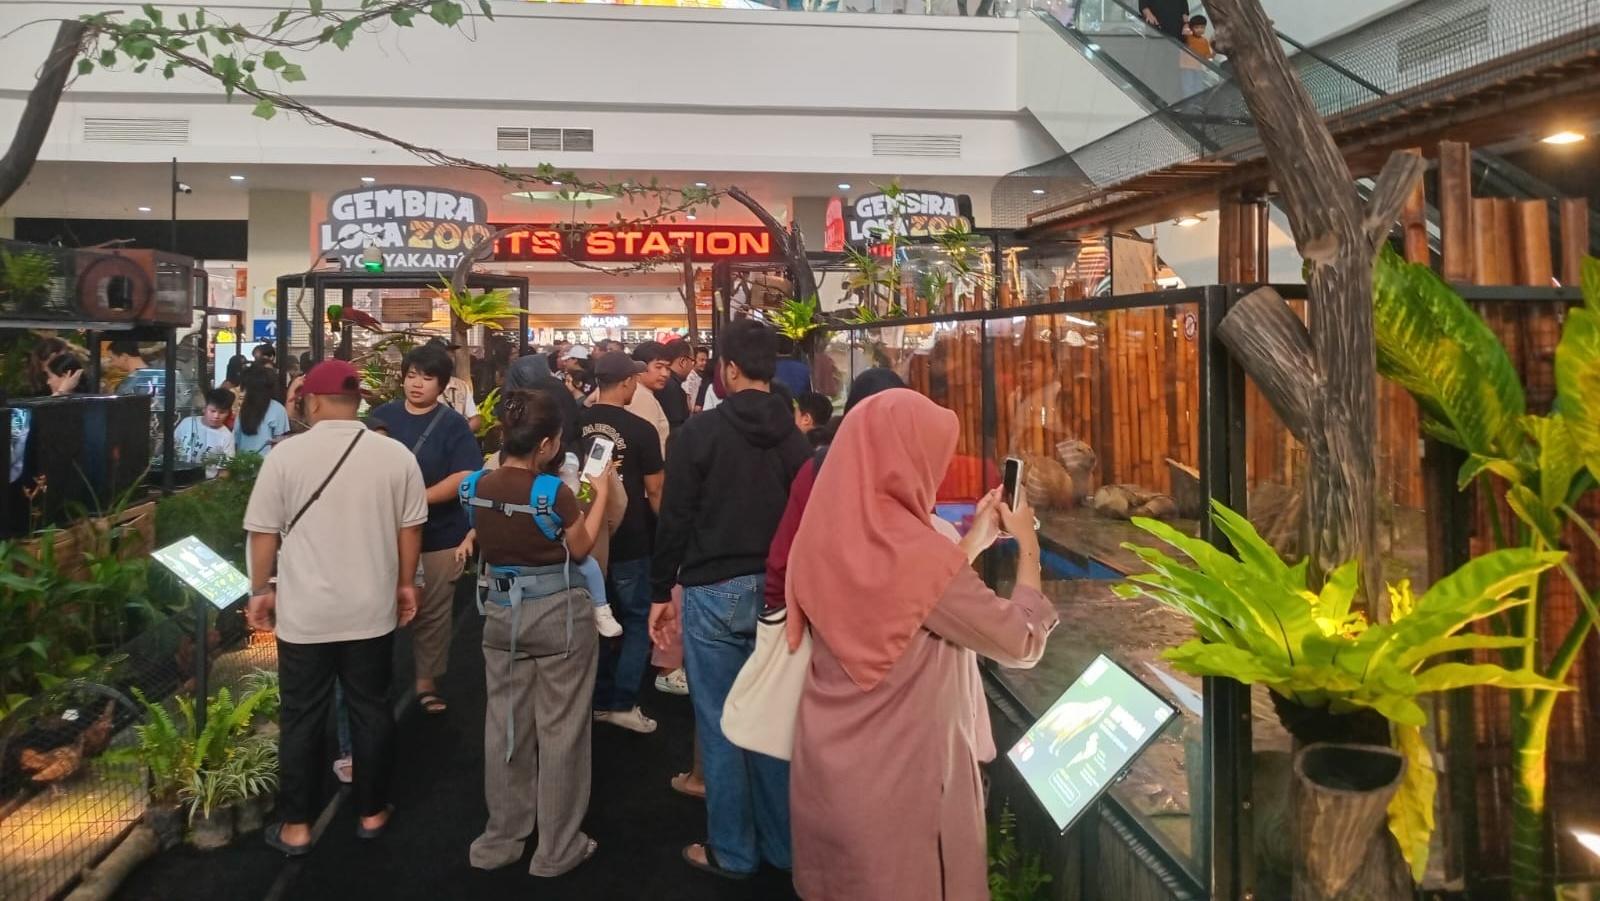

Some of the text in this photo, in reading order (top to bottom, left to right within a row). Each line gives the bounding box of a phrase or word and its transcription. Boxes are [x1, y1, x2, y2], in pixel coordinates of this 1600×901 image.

[332, 189, 475, 223] GEMBIRA
[407, 220, 490, 250] ZOO
[586, 231, 770, 256] STATION
[342, 251, 465, 268] YOYAKART
